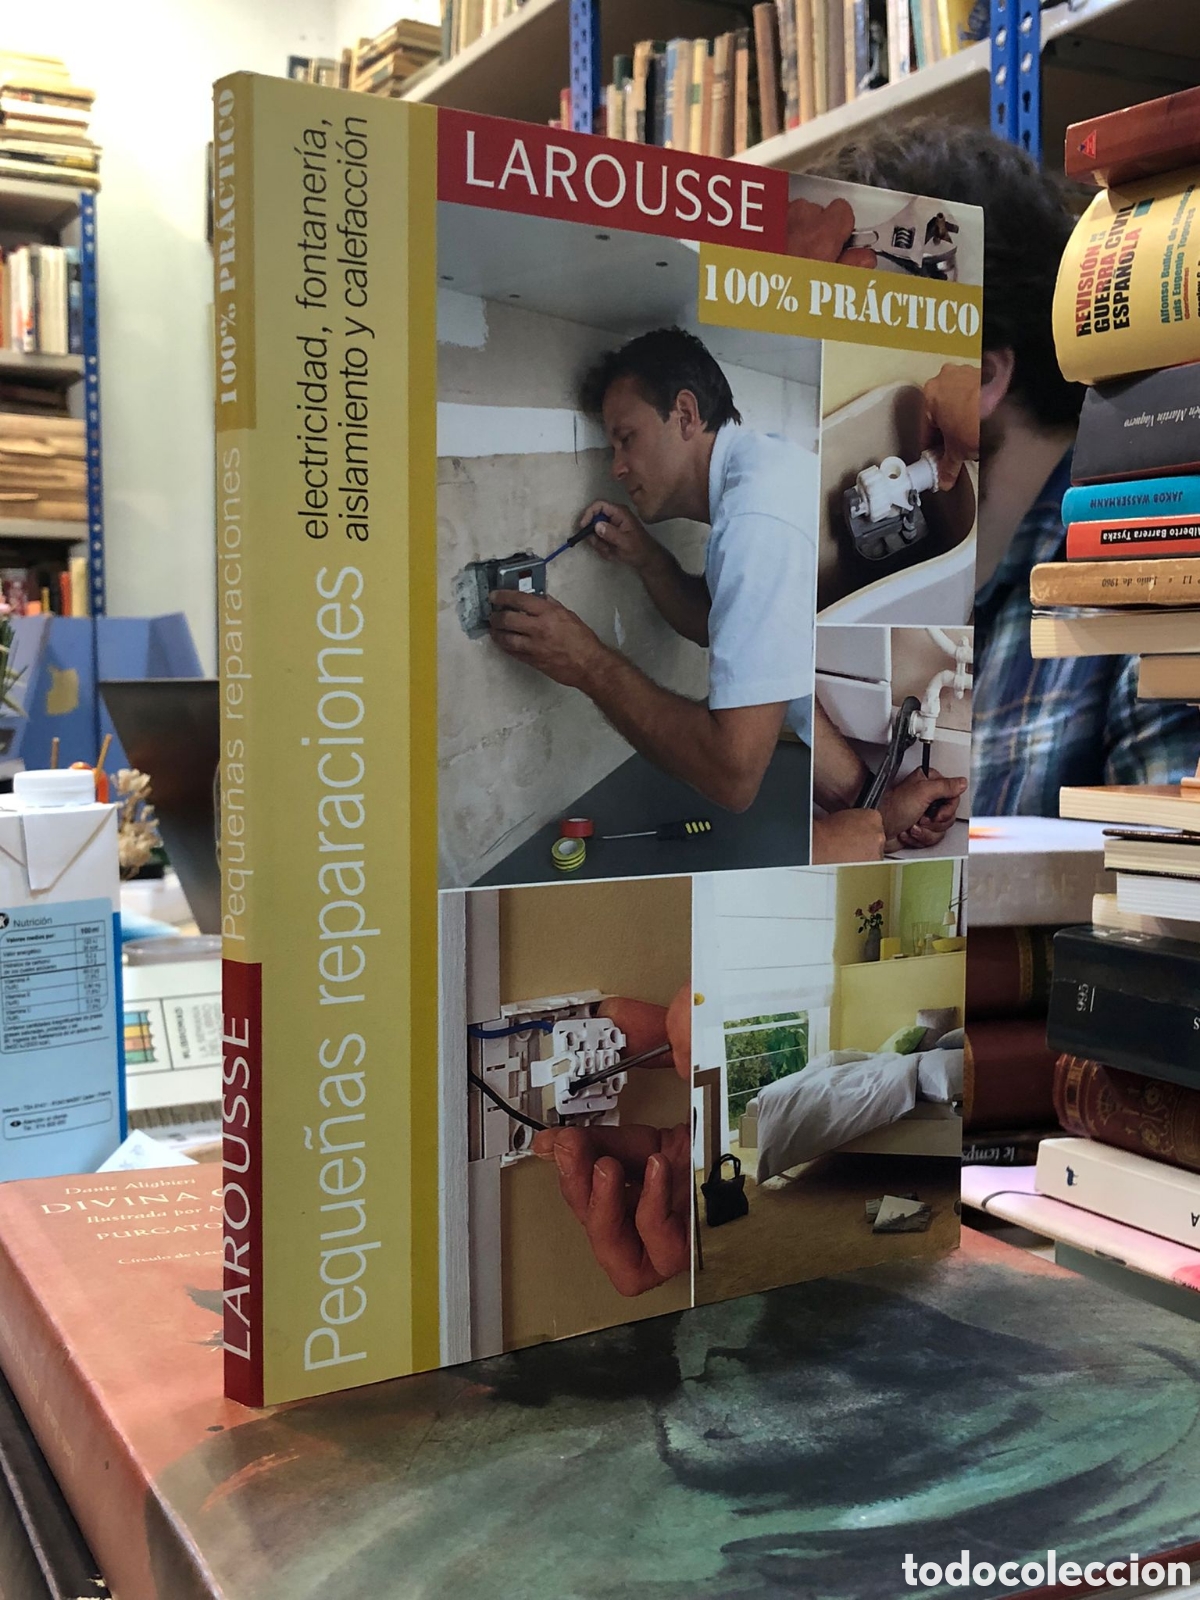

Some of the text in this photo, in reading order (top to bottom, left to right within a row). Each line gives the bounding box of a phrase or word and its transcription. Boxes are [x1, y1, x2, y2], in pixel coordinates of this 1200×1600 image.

[465, 130, 766, 233] LAROUSSE
[218, 88, 240, 405] 100% PRÁCTICO
[1168, 228, 1179, 241] de
[1094, 203, 1136, 333] GUERRA CIVIL
[1112, 227, 1142, 329] ESPAÑOLA
[1161, 244, 1174, 279] Bullón
[1173, 252, 1185, 296] Eugenio
[704, 263, 980, 338] 100% PRÁCTICO
[1076, 244, 1102, 337] REVISIÓN
[1161, 281, 1171, 323] Alfonso
[293, 117, 333, 541] electricidad, fontanería,
[336, 115, 375, 543] aislamiento y calefacción
[1173, 299, 1183, 321] Luis
[1123, 411, 1154, 427] Vaquero
[1090, 491, 1184, 509] JAKOB WASSERMANN
[1102, 529, 1132, 542] Tyszka
[1133, 528, 1168, 539] Barrera
[1122, 578, 1133, 587] de
[218, 446, 254, 942] Pequeñas reparaciones
[13, 916, 53, 928] Nutrición
[301, 566, 382, 1371] Pequeñas reparaciones
[41, 1192, 201, 1214] DIVINA
[65, 1178, 196, 1195] Dante Alighieri
[222, 1016, 252, 1362] LAROUSSE
[87, 1211, 168, 1224] Ilustrada
[174, 1207, 203, 1217] por
[117, 1255, 172, 1265] Círculo
